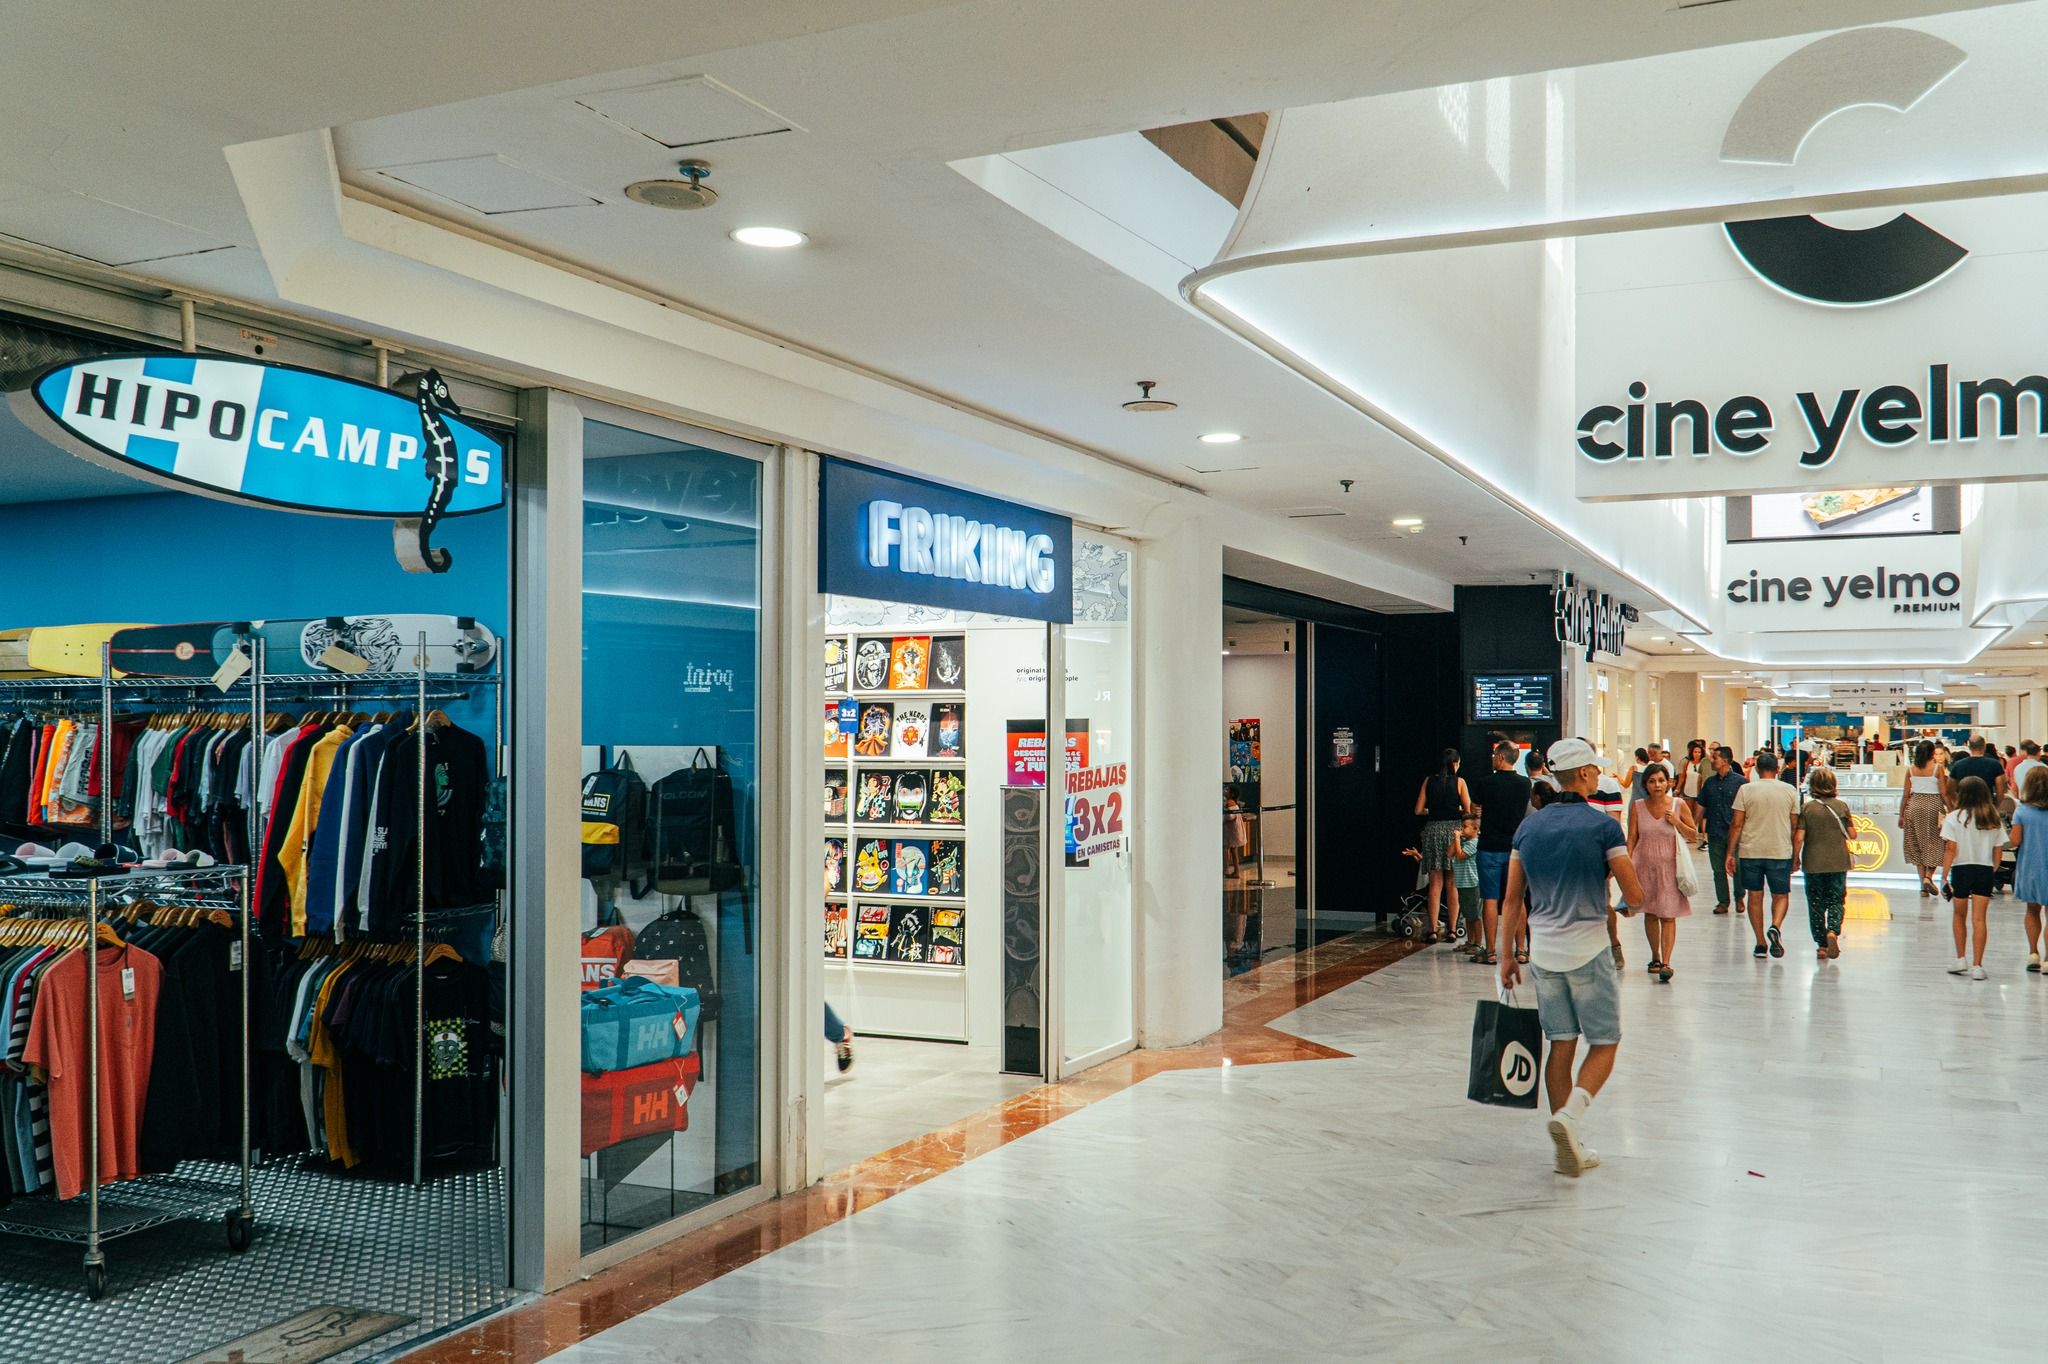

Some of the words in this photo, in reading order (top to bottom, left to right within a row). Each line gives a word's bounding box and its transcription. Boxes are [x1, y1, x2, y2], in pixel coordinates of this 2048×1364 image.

[1577, 381, 1773, 461] cine
[868, 499, 1056, 594] FRIKING
[1727, 569, 1812, 603] cine
[1822, 566, 1960, 608] yelmo
[1894, 602, 1960, 613] PREMIUM
[841, 708, 857, 718] 3x2
[1014, 761, 1025, 773] 2
[1074, 791, 1123, 842] 3x2
[1077, 848, 1086, 859] EN
[1087, 839, 1121, 856] CAMISETAS
[637, 1021, 669, 1050] HH
[1506, 1053, 1532, 1082] JD
[633, 1090, 668, 1125] HH
